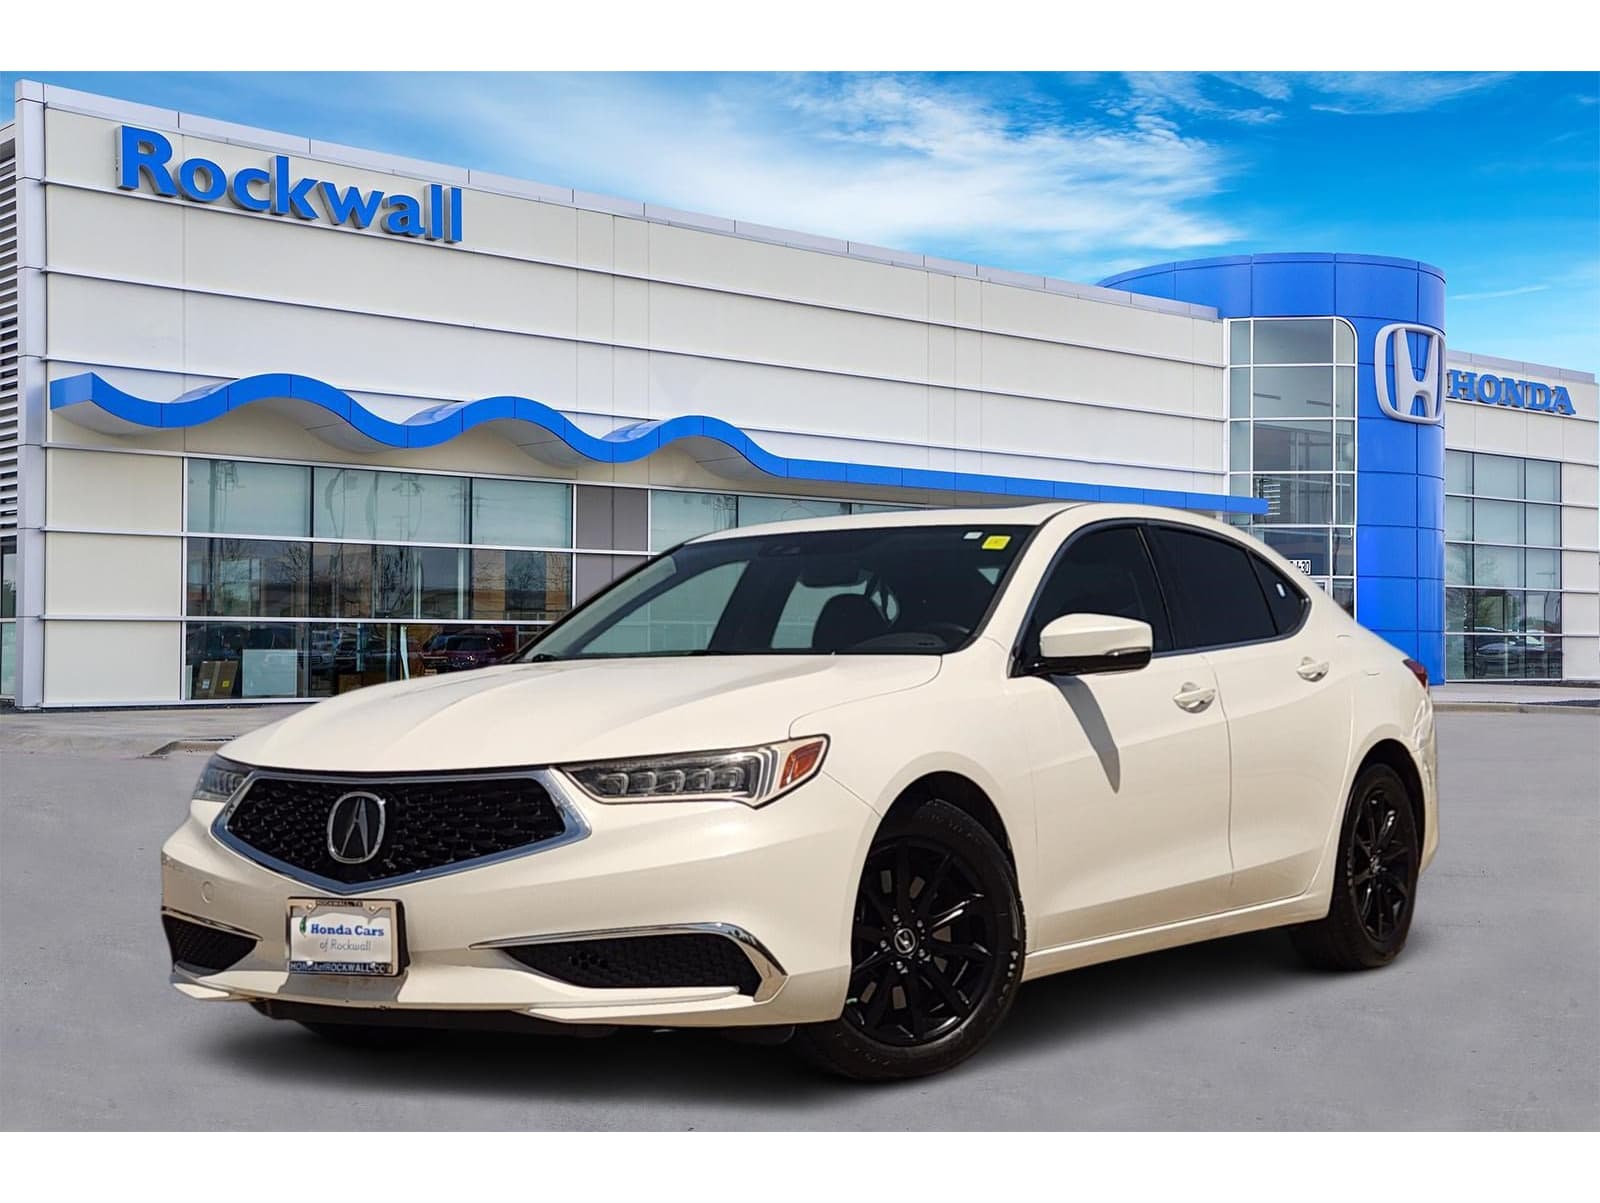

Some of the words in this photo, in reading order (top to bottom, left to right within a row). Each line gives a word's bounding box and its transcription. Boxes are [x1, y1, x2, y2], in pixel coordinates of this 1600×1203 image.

[117, 125, 463, 243] Rockwall
[1447, 369, 1576, 415] HONDA
[310, 923, 352, 936] Honda
[355, 925, 385, 937] Cars
[319, 938, 328, 952] of
[331, 939, 371, 952] Rockwall
